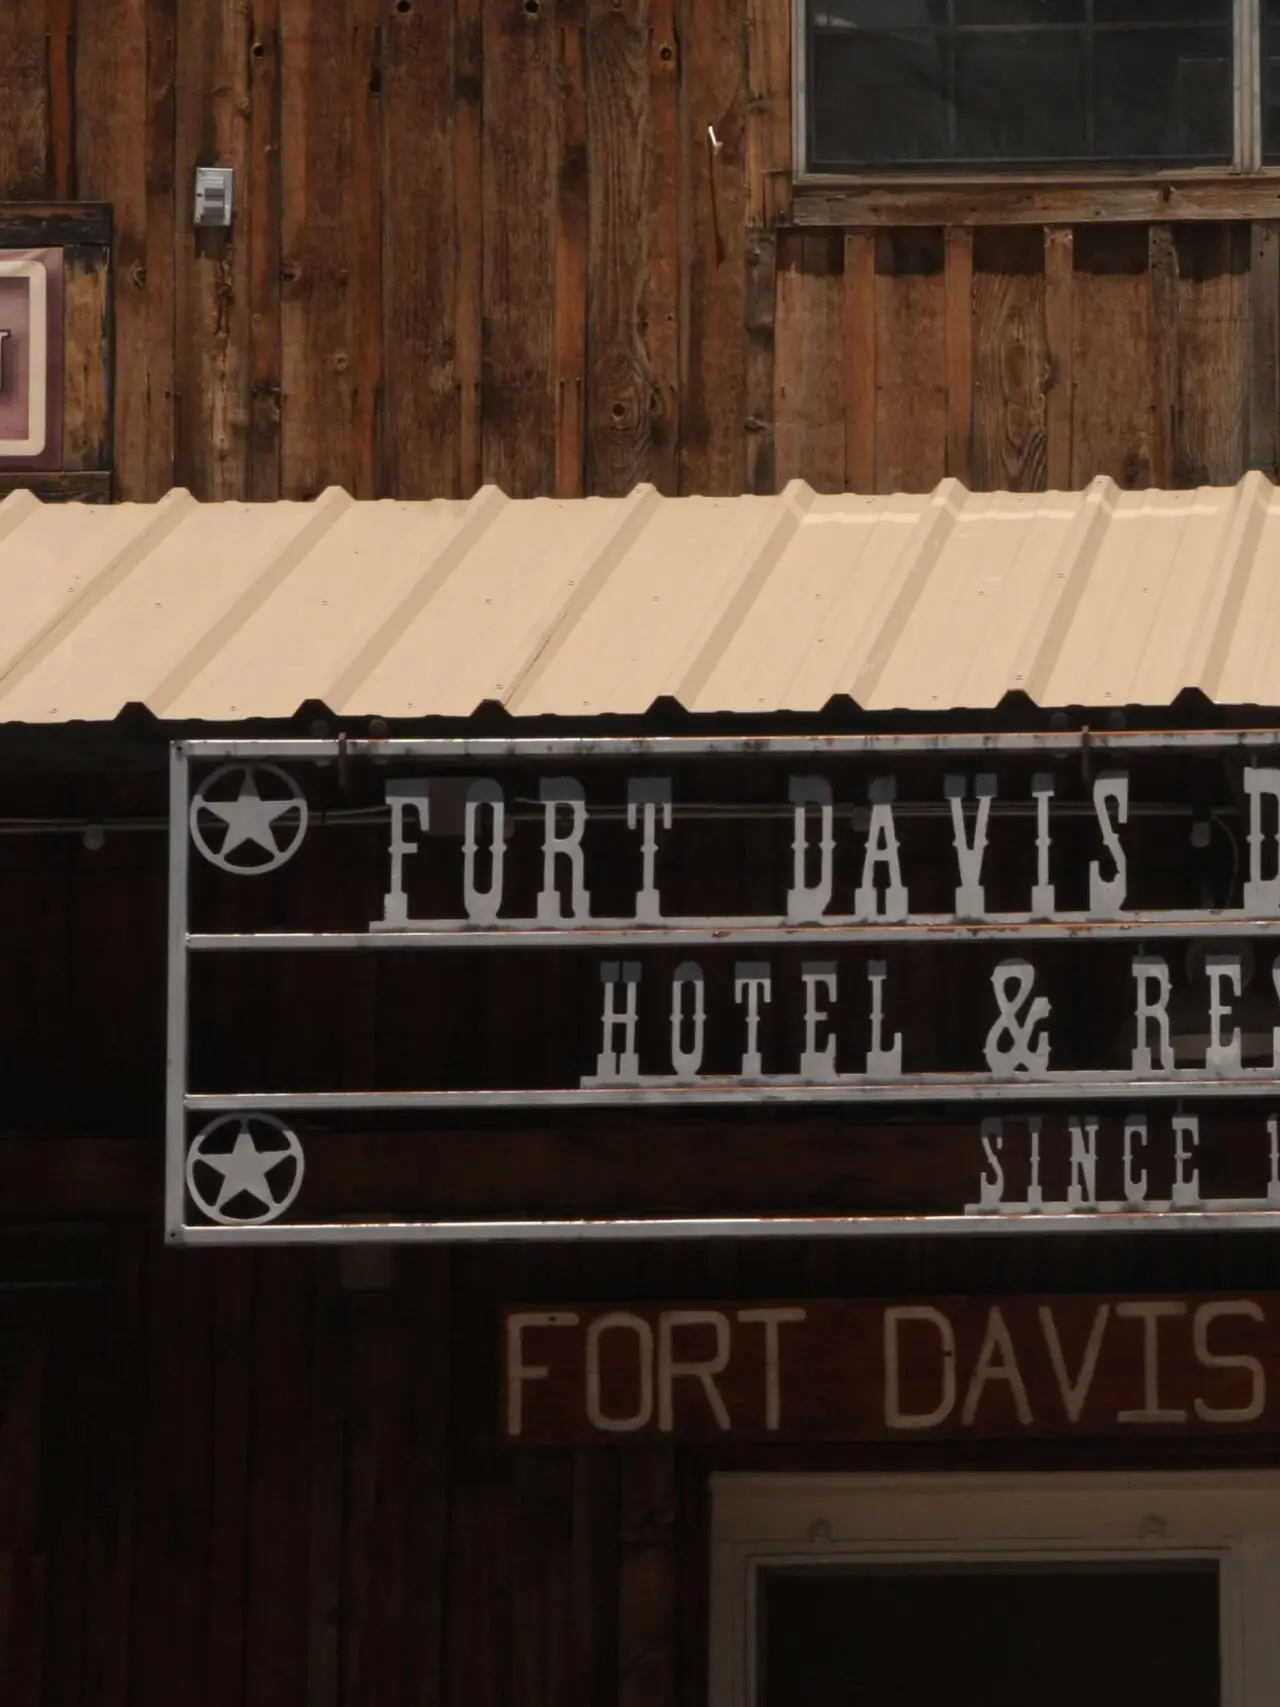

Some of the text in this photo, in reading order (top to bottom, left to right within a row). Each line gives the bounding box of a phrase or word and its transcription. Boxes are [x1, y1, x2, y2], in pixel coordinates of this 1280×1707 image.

[382, 778, 672, 921] FORT
[786, 771, 1130, 923] DAVIS
[595, 960, 903, 1080] HOTEL
[982, 959, 1052, 1076] &
[978, 1115, 1201, 1210] SINCE
[505, 1306, 806, 1436] FORT
[882, 1300, 1268, 1430] DAVIS
